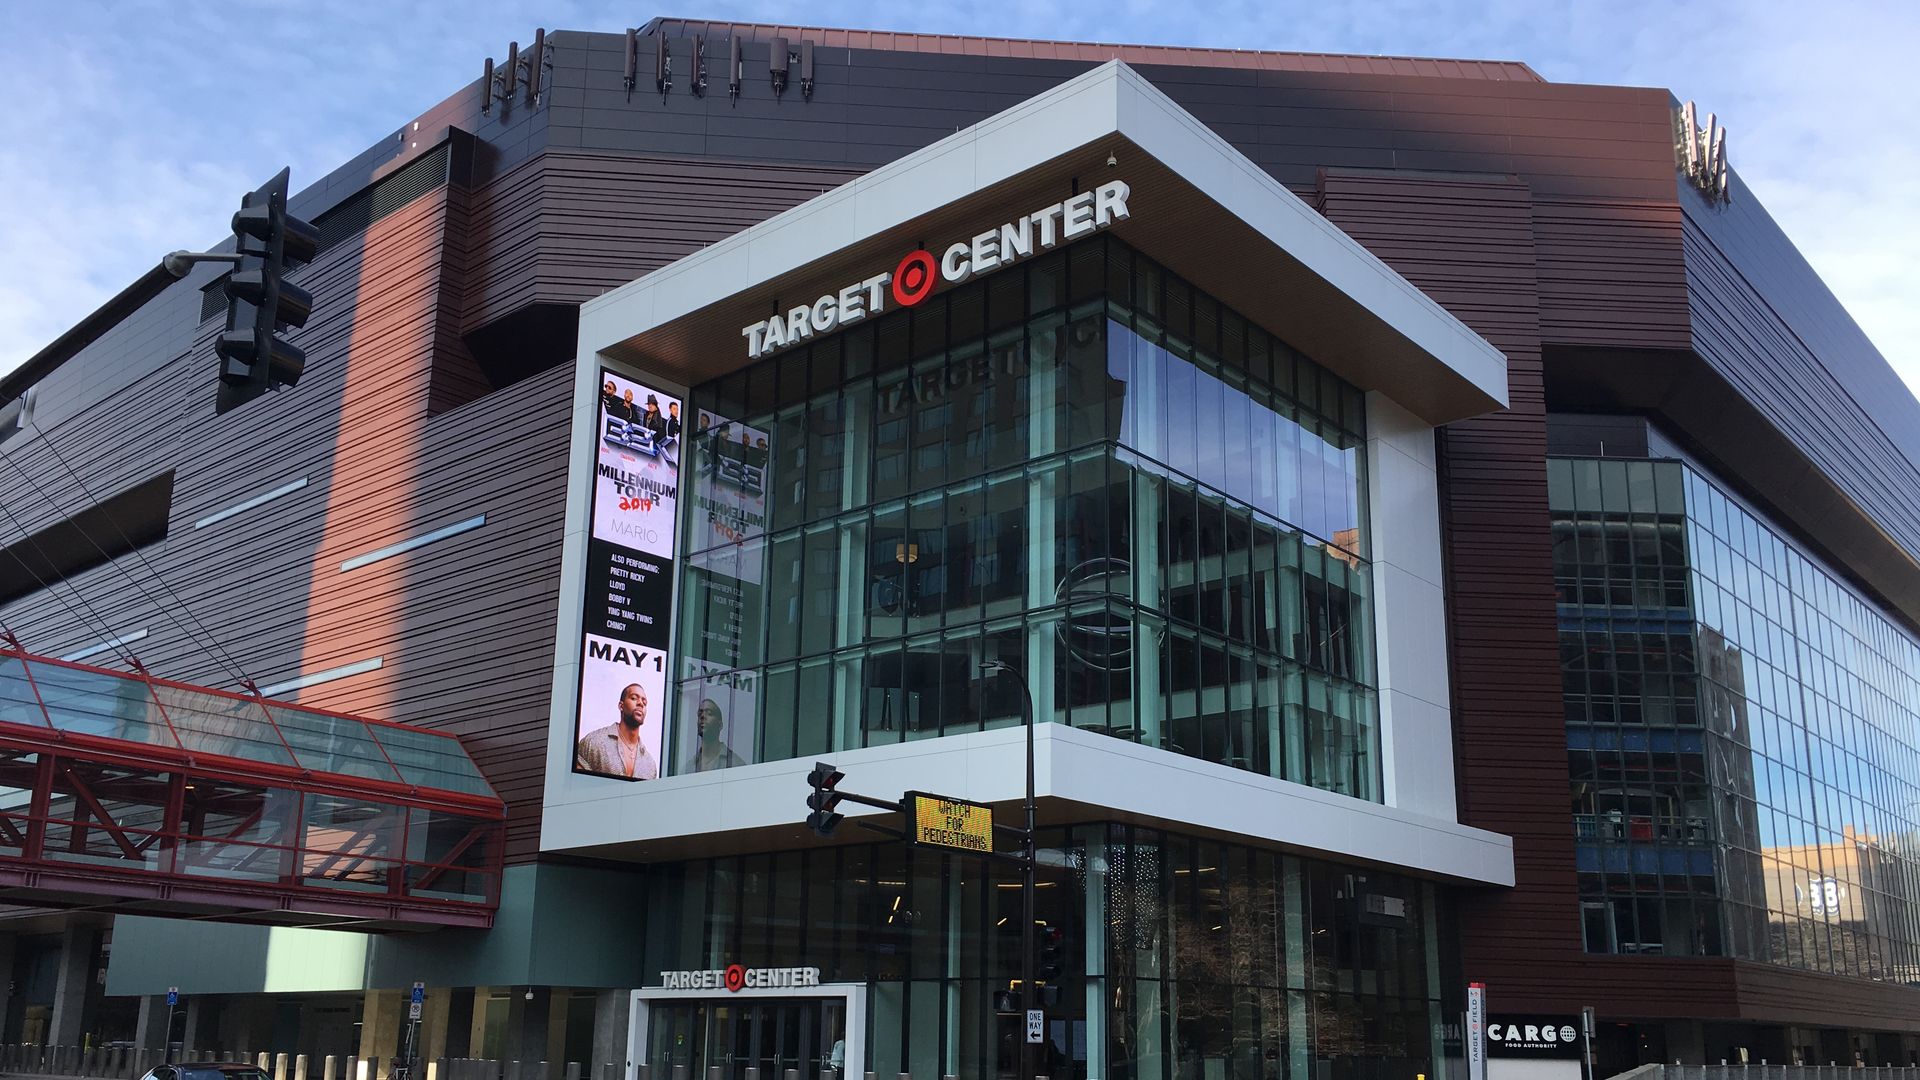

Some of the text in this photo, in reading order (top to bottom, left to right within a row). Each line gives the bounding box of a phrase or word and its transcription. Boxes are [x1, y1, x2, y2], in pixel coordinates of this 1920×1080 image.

[742, 179, 1131, 359] TARGET CENTER
[599, 463, 676, 499] MILLENNIUM
[614, 481, 660, 507] TOUR
[618, 496, 652, 513] 2019
[611, 518, 658, 544] MARIO
[611, 553, 660, 574] ALSO PERFORMING:
[610, 567, 645, 583] PRETTY RICKY
[609, 579, 626, 591] LLOYD
[609, 593, 625, 604] BOBBY
[608, 606, 653, 625] YING YANG TWINS
[607, 620, 626, 631] CHINGY
[589, 640, 663, 673] MAY 1
[938, 800, 970, 818] WATCH
[946, 815, 963, 831] FOR
[923, 826, 987, 849] PEDESTRIANS
[660, 967, 820, 989] TARGET CENTER
[1029, 1012, 1041, 1021] ONE
[1029, 1021, 1041, 1030] WAY
